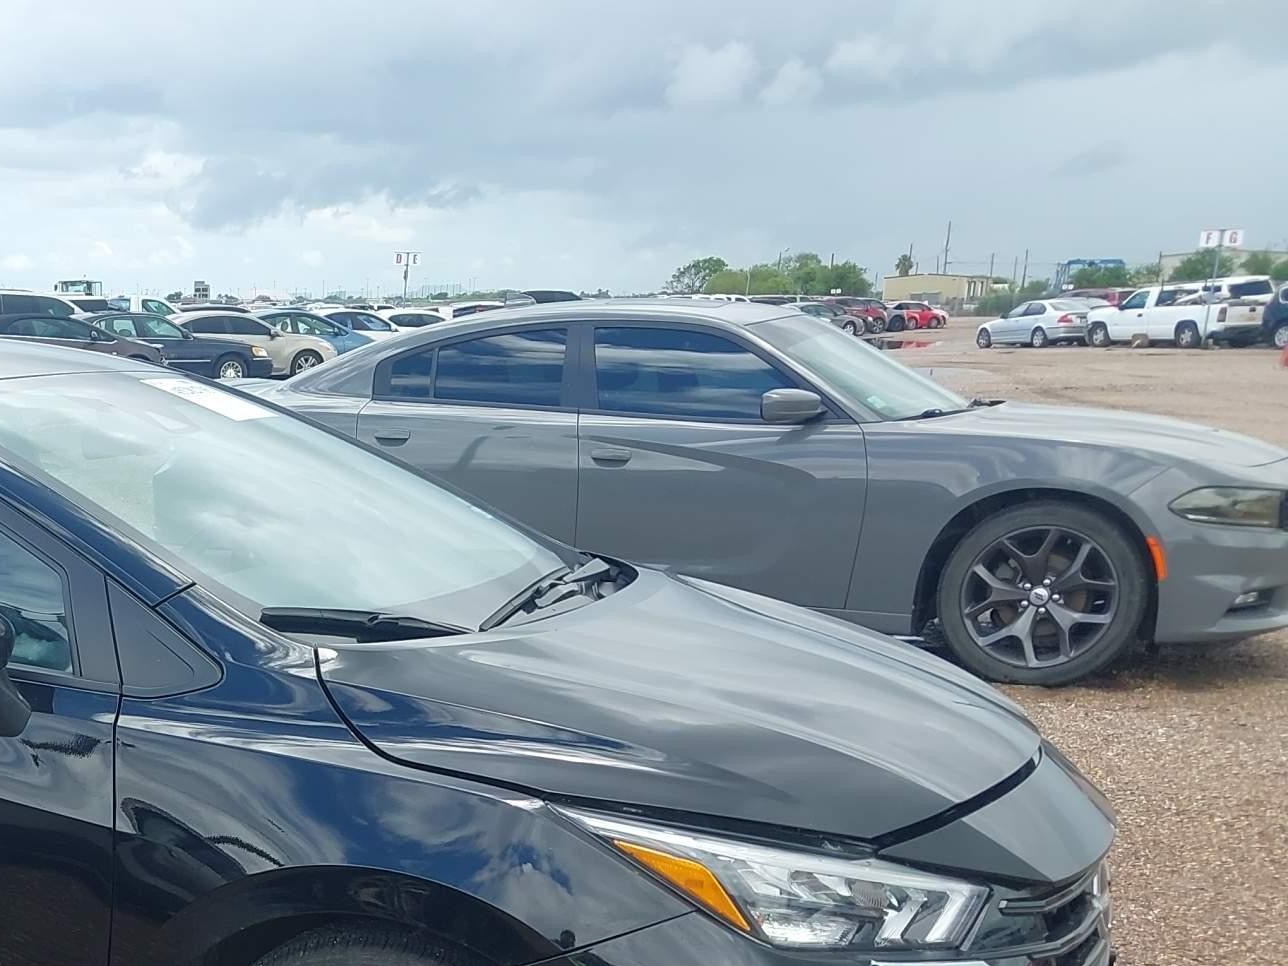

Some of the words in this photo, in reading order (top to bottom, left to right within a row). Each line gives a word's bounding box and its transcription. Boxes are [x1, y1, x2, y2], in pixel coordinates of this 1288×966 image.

[1206, 232, 1213, 244] F
[1229, 231, 1238, 244] G
[396, 253, 402, 264] D
